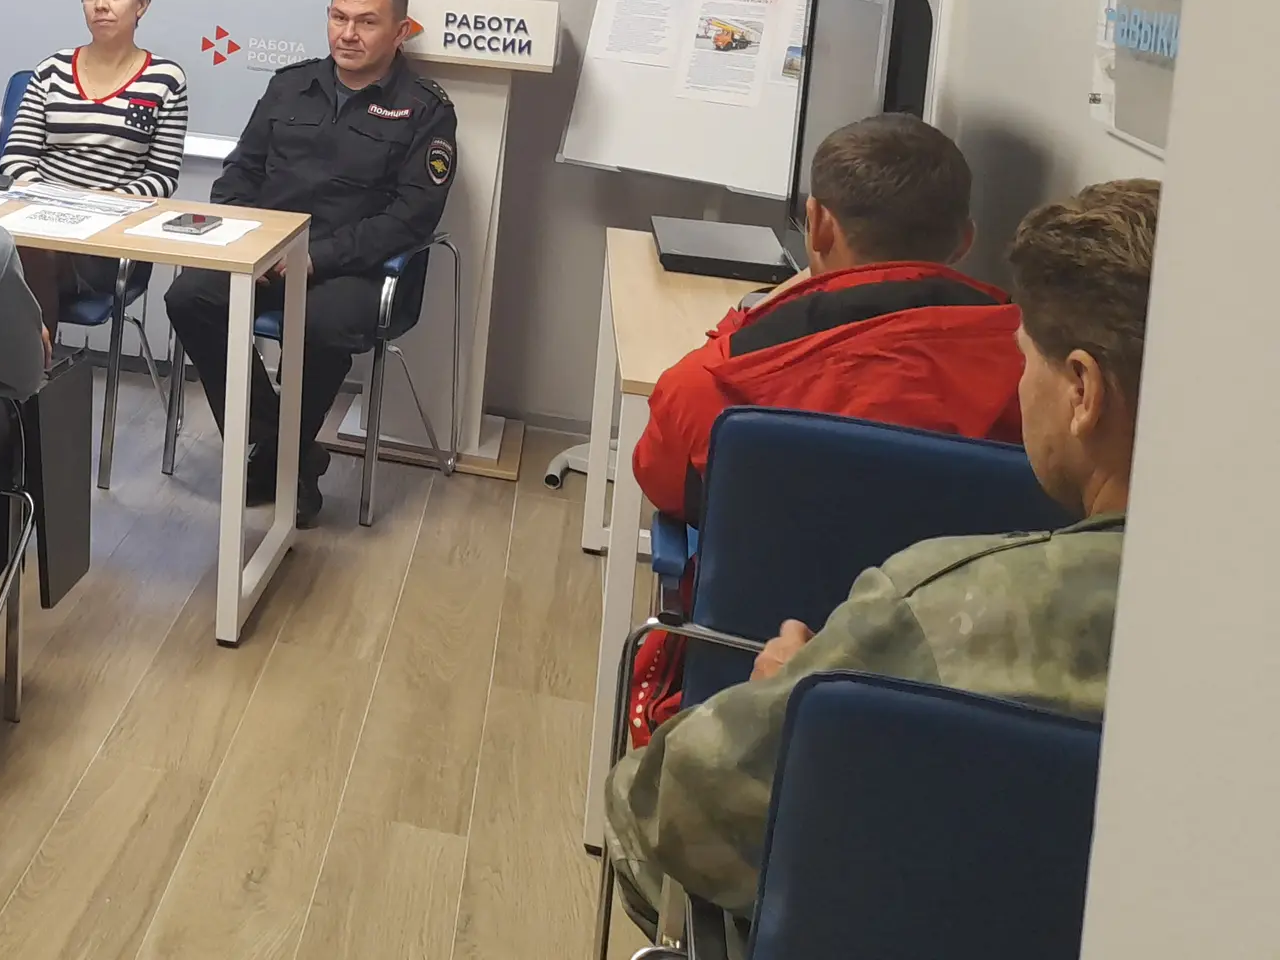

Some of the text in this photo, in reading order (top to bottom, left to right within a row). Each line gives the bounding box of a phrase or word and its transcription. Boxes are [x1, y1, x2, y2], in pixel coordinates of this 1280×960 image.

[444, 12, 529, 36] РАБОТА
[248, 38, 306, 53] РАБОТА
[443, 31, 532, 56] РОССИИ
[370, 105, 409, 118] ПОЛИЦИЯ
